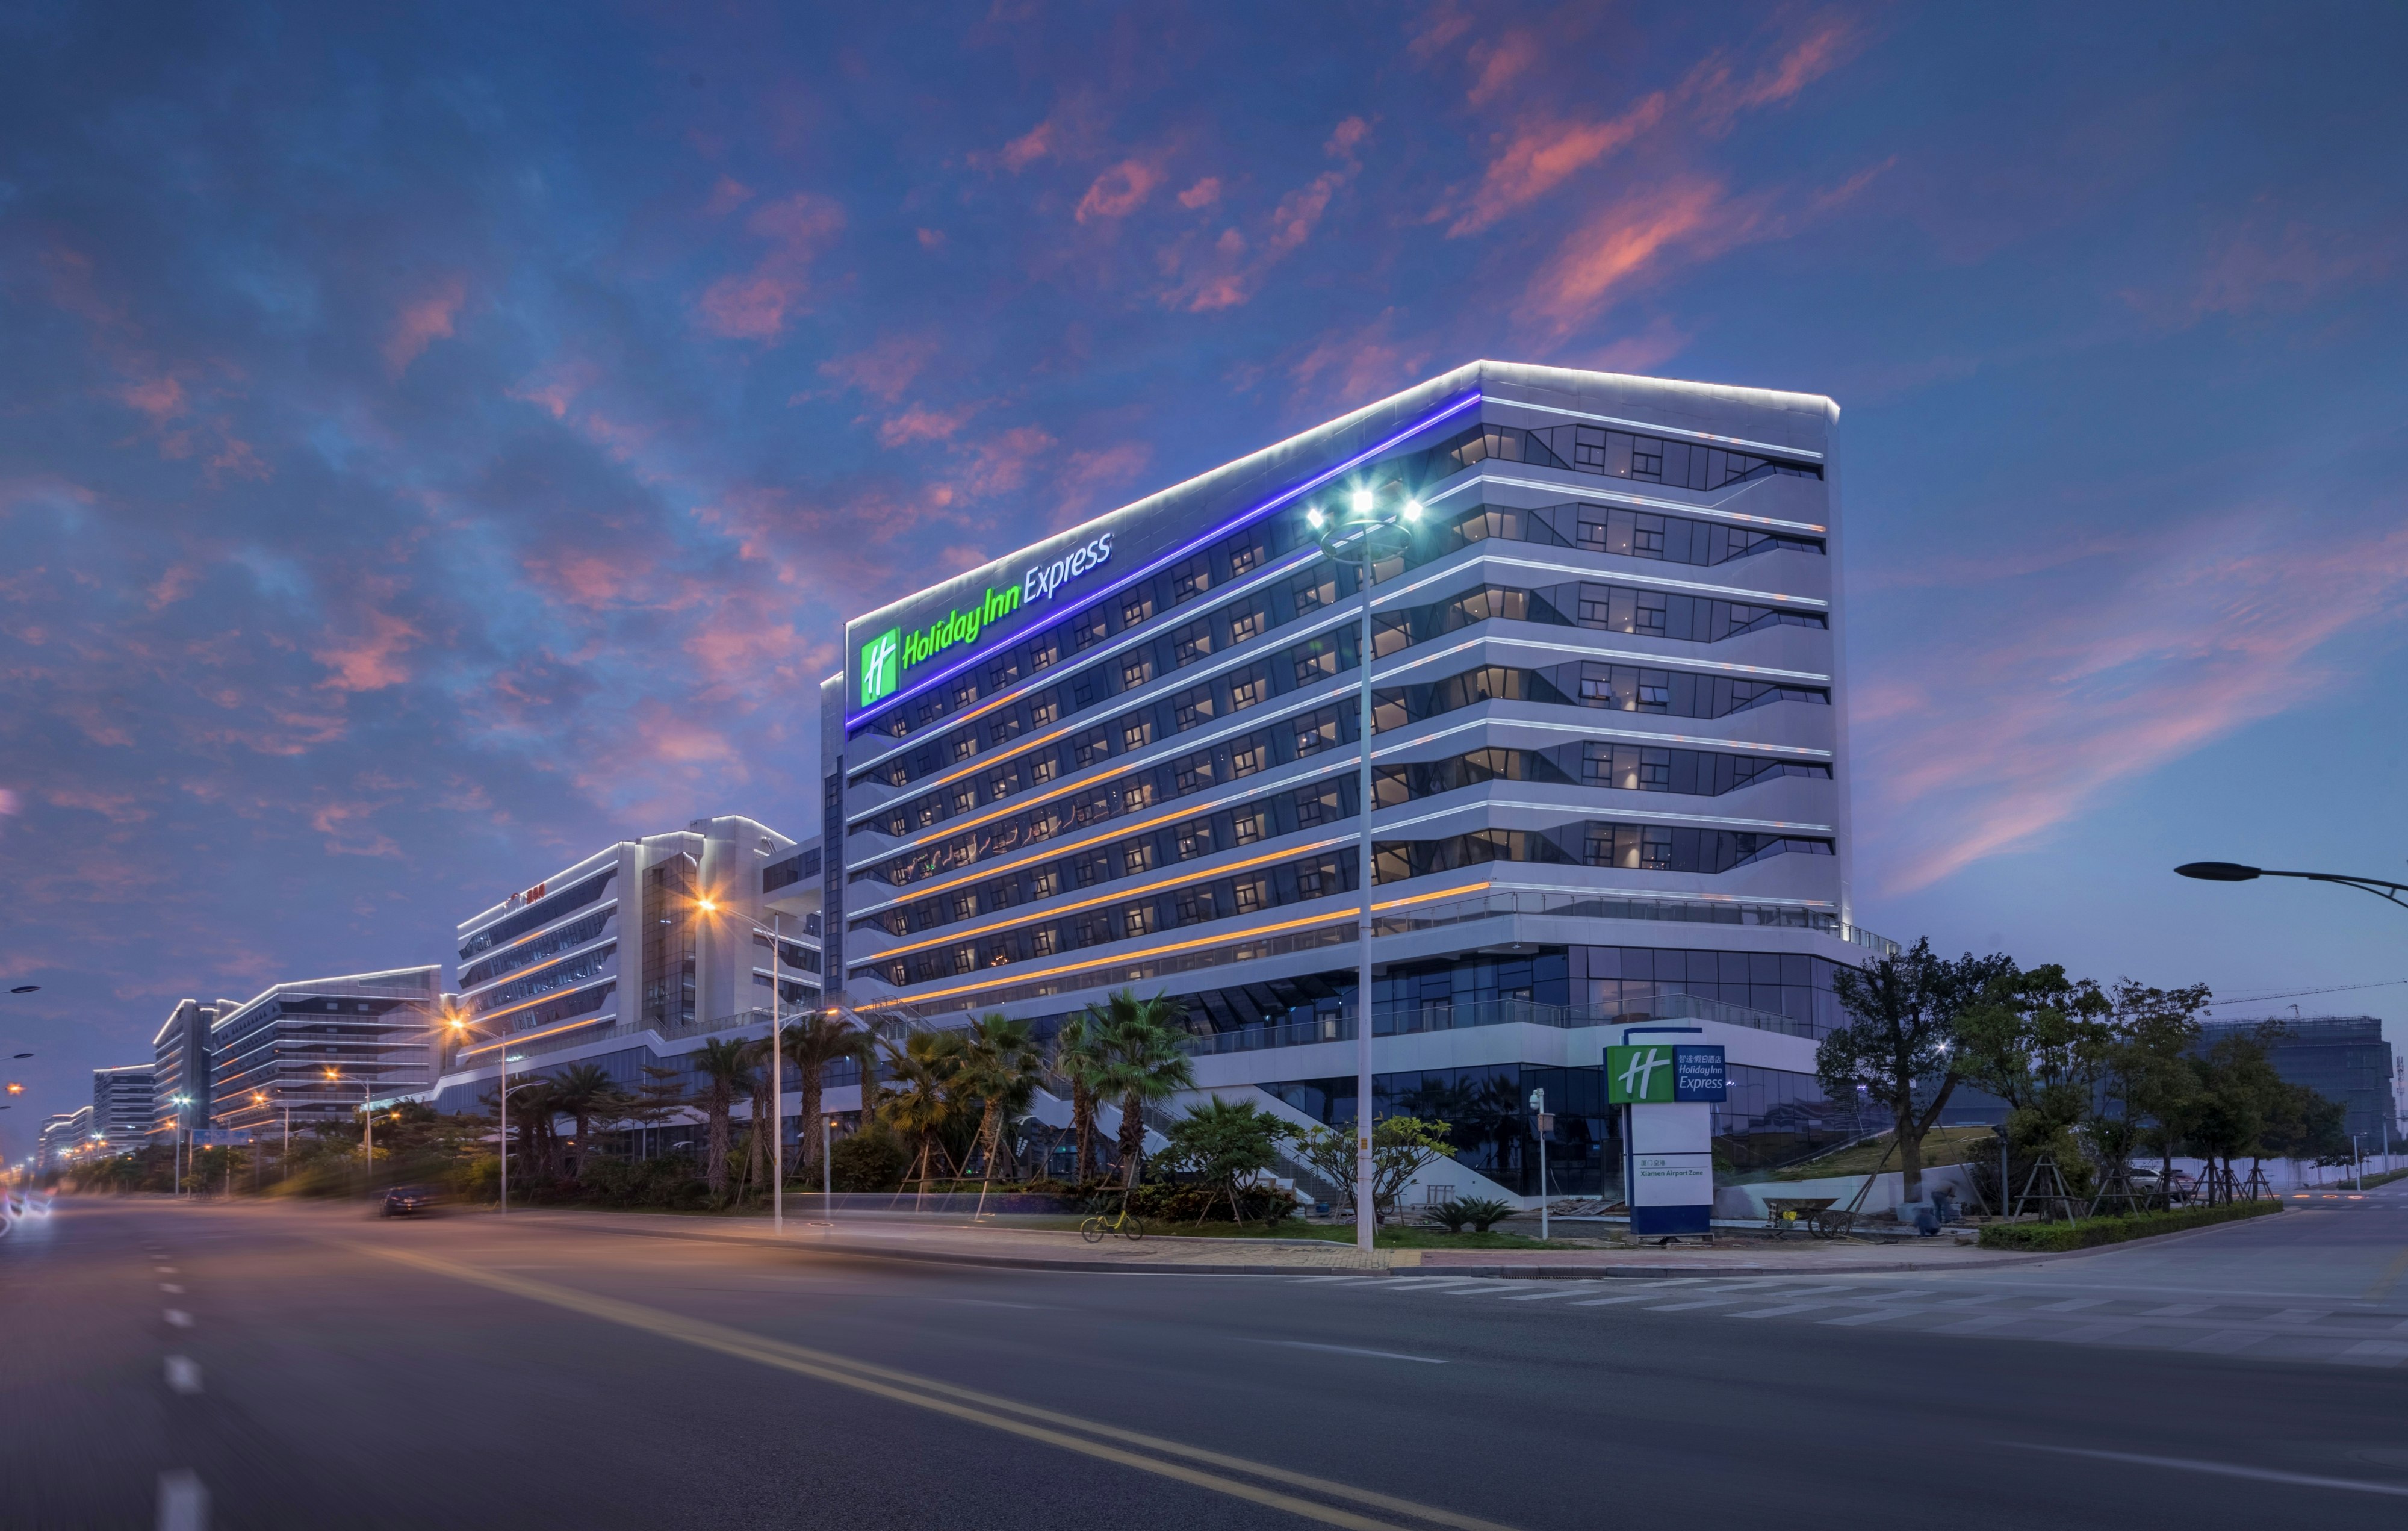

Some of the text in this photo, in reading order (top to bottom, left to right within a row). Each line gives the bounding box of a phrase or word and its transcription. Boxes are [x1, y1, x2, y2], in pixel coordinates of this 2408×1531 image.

[902, 532, 1111, 669] Holiday Inn Express
[1678, 1055, 1722, 1064] 智选假日酒店
[1679, 1064, 1722, 1076] Holiday Inn
[1680, 1076, 1722, 1092] Express
